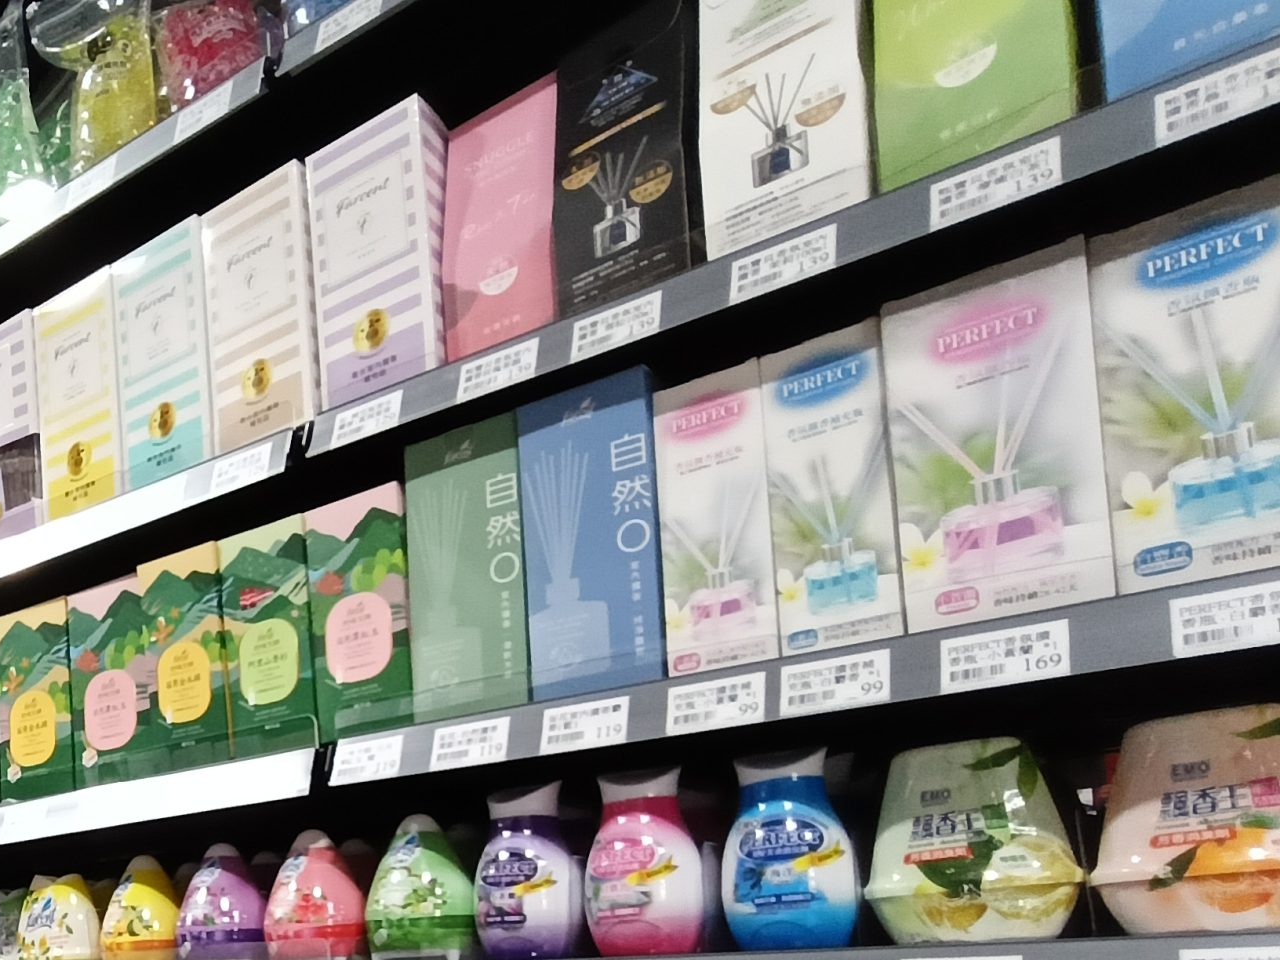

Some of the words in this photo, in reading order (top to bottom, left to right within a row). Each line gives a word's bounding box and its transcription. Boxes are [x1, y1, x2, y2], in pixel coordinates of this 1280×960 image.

[1146, 222, 1270, 279] PERFECT
[935, 306, 1039, 354] PERFECT
[782, 359, 861, 399] PERFECT
[671, 400, 743, 434] PERFECT
[1023, 653, 1063, 673] 169
[861, 680, 883, 695] 99
[738, 702, 759, 716] 99
[596, 724, 623, 739] 119
[1160, 784, 1249, 818] 飄香王
